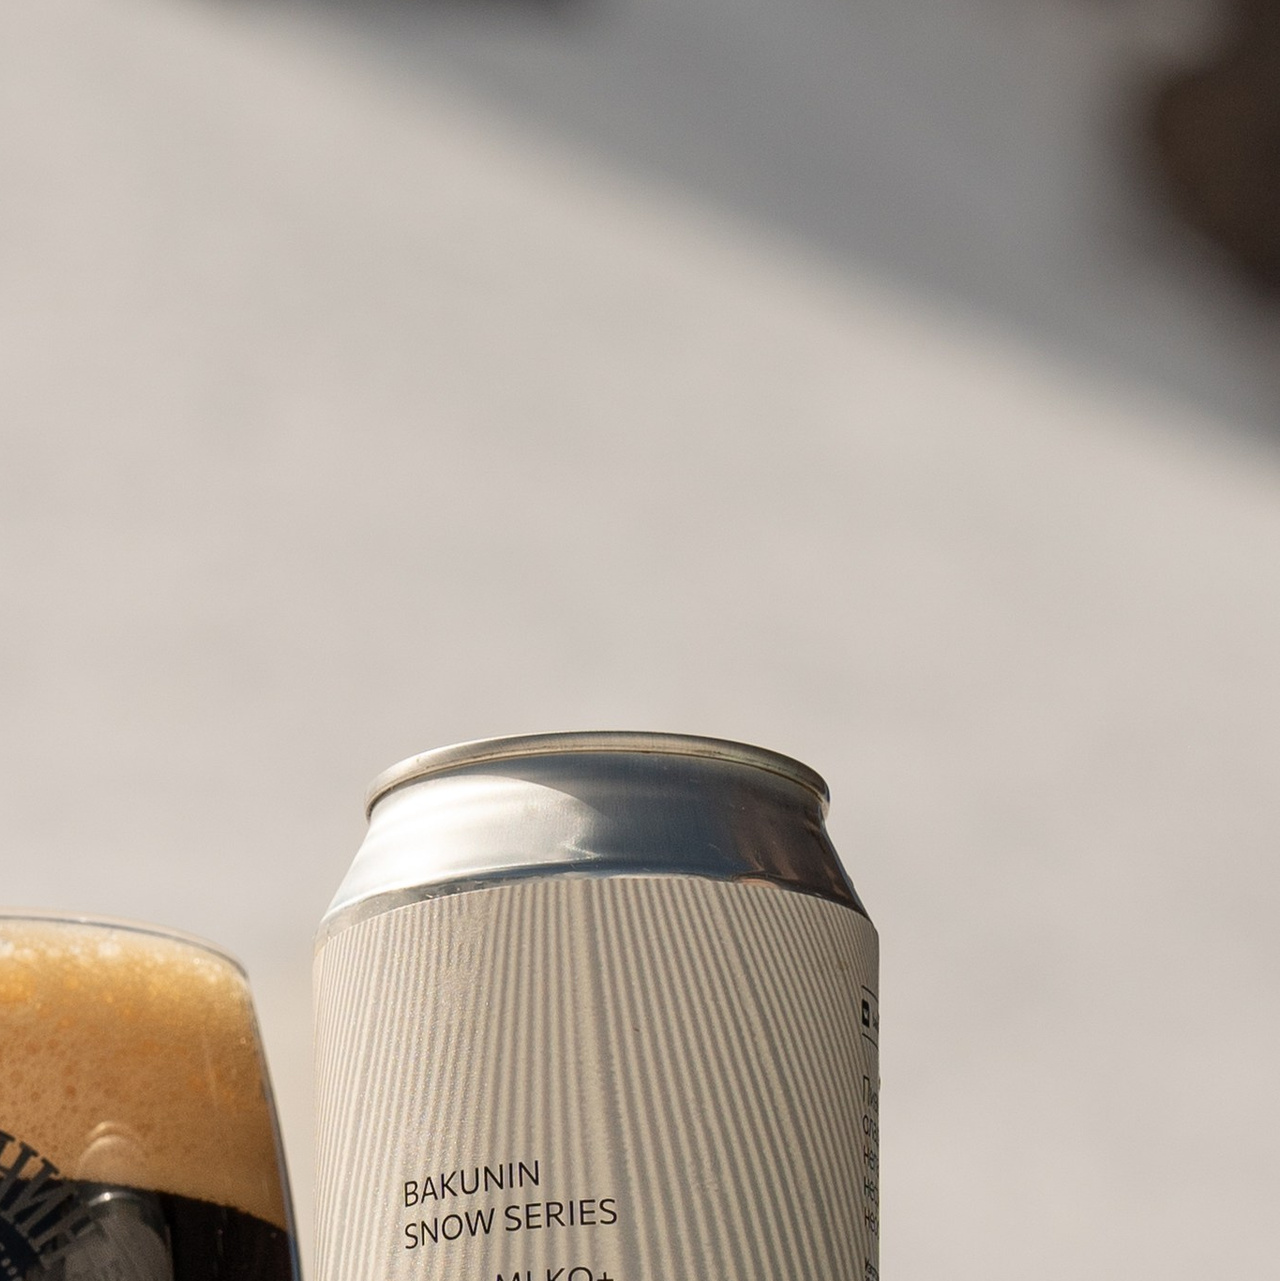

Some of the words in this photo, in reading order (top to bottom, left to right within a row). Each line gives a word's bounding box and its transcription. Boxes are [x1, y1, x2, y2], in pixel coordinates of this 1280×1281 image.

[404, 1160, 540, 1207] BAKUNIN
[404, 1207, 495, 1249] SNOW
[504, 1198, 618, 1231] SERIES
